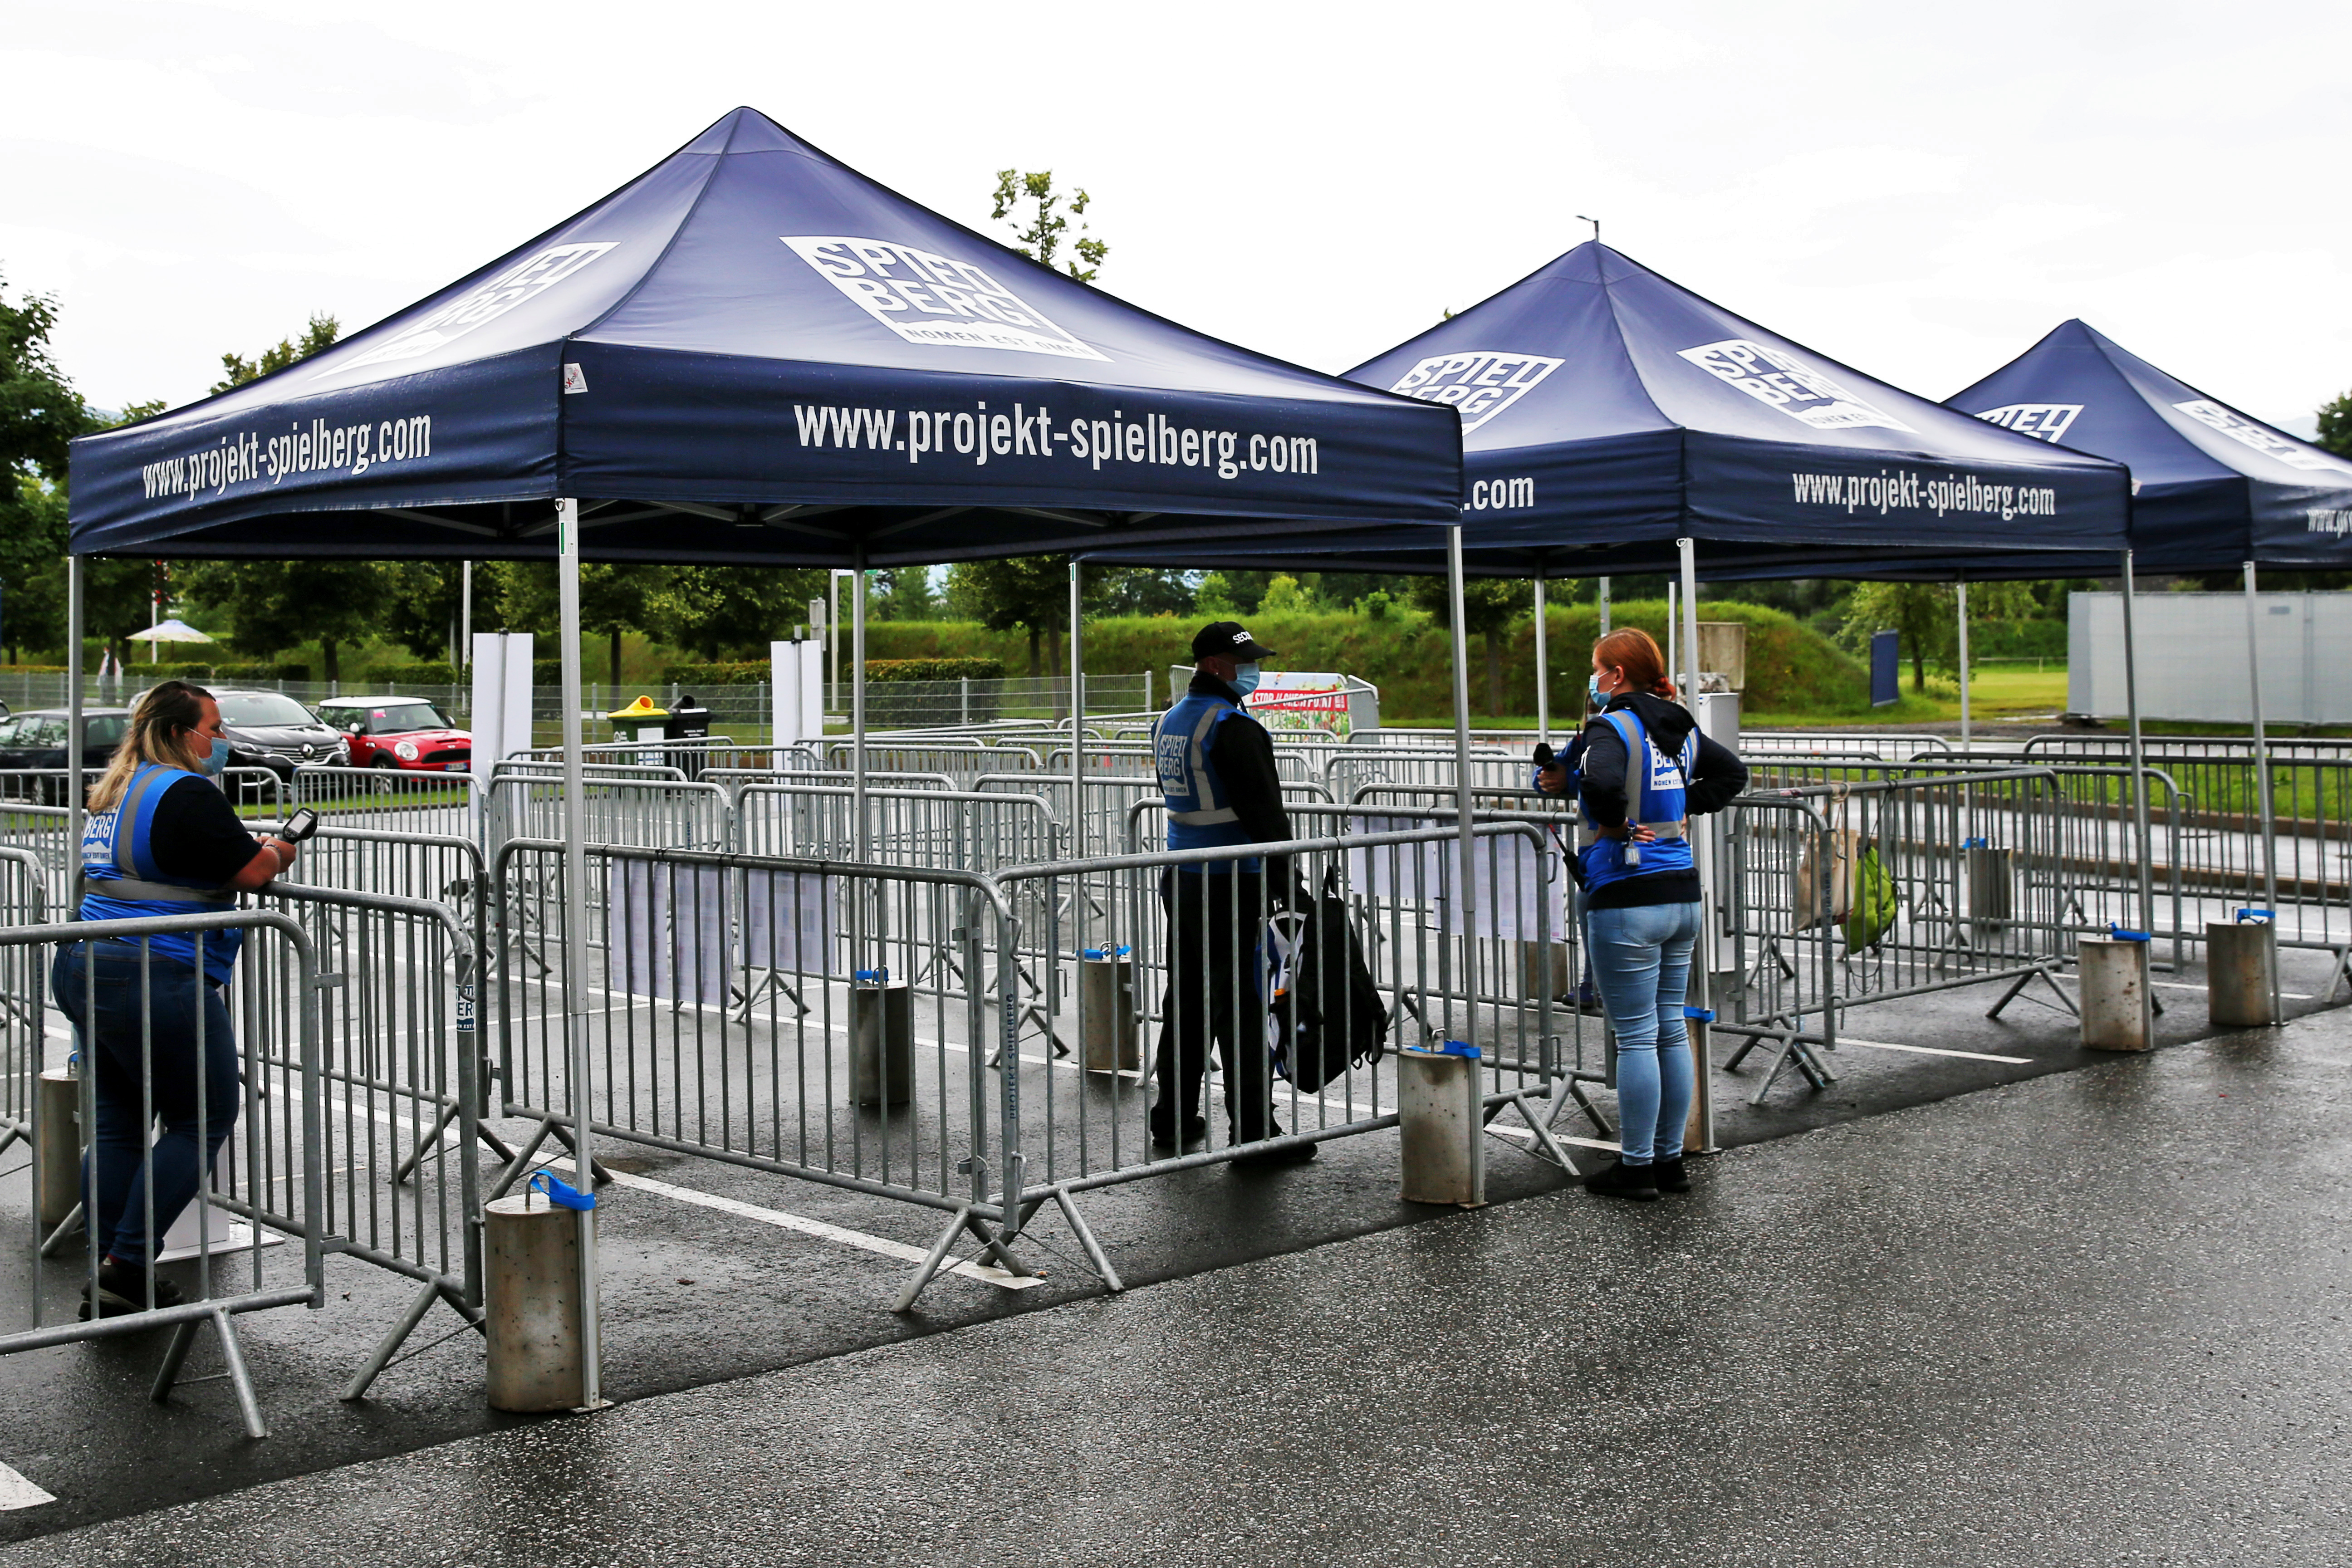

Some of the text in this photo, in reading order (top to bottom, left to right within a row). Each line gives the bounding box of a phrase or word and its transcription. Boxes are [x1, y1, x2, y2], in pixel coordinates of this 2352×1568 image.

[812, 244, 1004, 293] SPIEL
[848, 277, 1041, 329] BERG
[908, 329, 1094, 356] NOMEN EST OMEN
[1400, 358, 1531, 389] SPIEL
[1402, 385, 1504, 414] ERG
[1981, 409, 2060, 431] IEL
[794, 401, 1318, 480] www.projekt-spielberg.com
[142, 414, 431, 501] www.projekt-spielberg.com
[1793, 469, 2055, 521] www.projekt-spielberg.com
[1160, 737, 1185, 757] SPIEL
[1158, 757, 1181, 776] BERG
[83, 815, 113, 838] BERG
[456, 1001, 474, 1016] ER
[1005, 993, 1015, 1060] SPIELBERG
